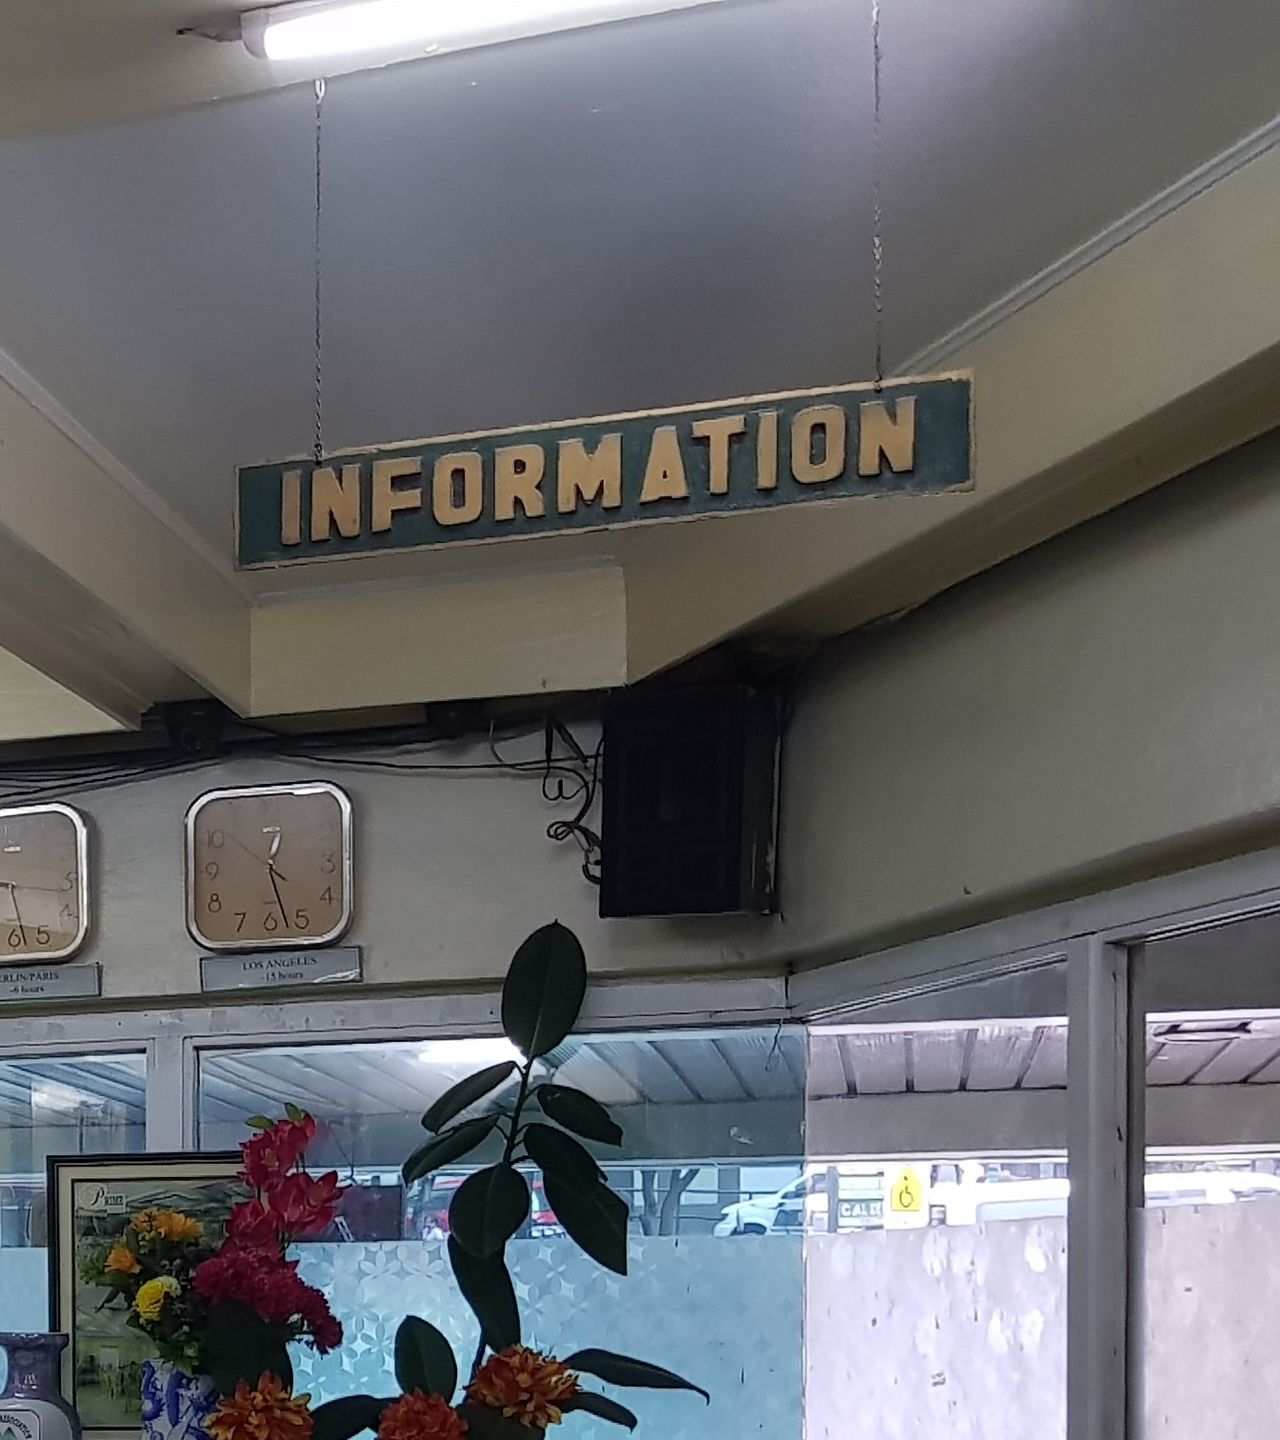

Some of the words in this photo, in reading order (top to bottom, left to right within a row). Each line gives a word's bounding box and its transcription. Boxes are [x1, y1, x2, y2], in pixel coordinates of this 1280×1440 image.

[279, 396, 915, 546] INFORMATION
[205, 862, 219, 880] 9
[208, 893, 222, 913] 8
[320, 886, 332, 905] 4
[234, 912, 246, 932] 7
[264, 912, 277, 931] 6
[295, 909, 309, 929] 5
[8, 929, 21, 947] 6
[36, 925, 50, 945] 5
[242, 960, 263, 971] LOS
[265, 957, 318, 969] ANGELES
